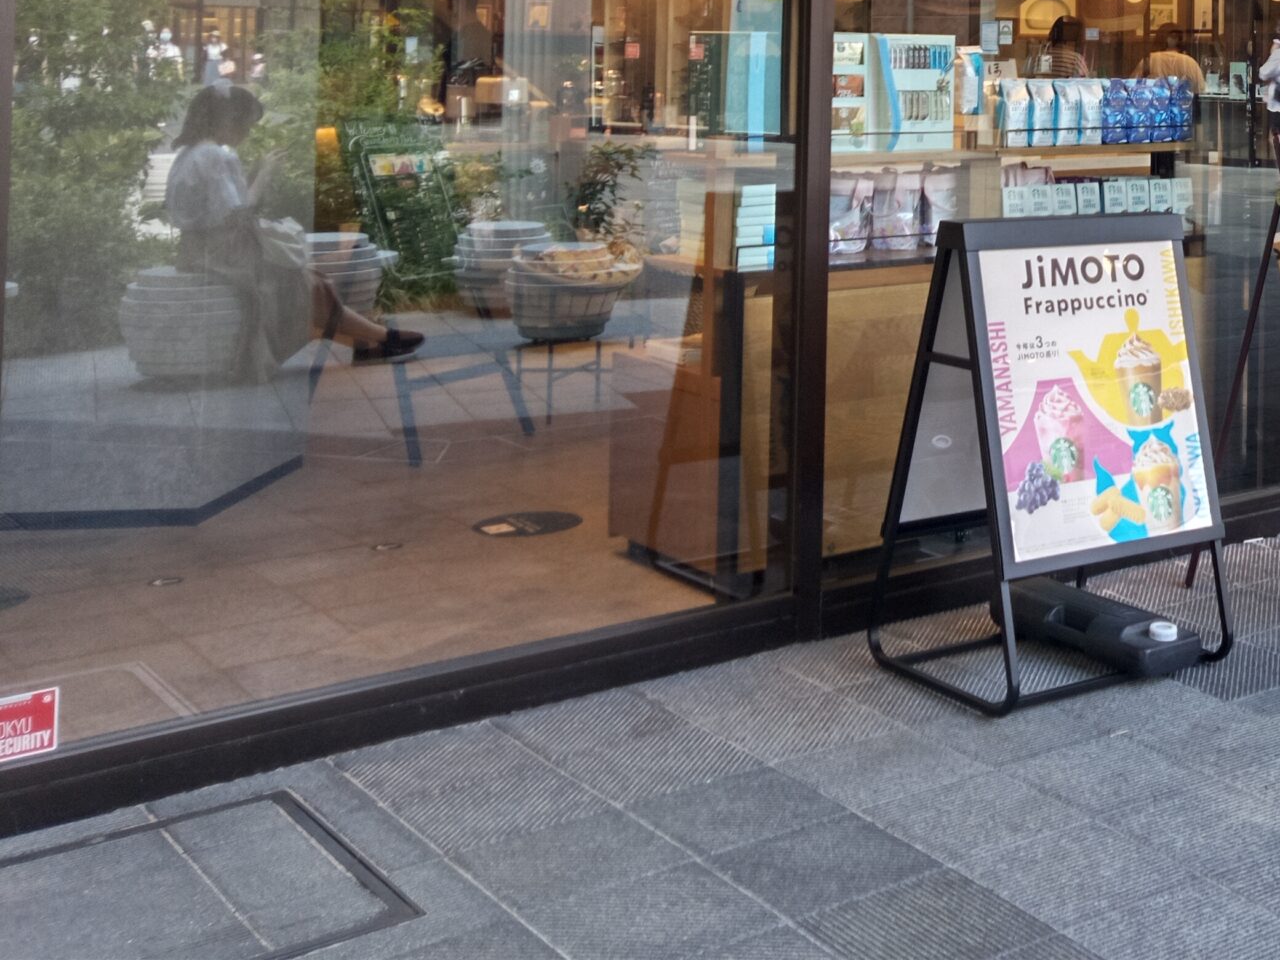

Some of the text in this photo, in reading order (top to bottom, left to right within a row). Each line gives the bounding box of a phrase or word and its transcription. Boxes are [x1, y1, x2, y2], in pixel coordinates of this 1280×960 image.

[1023, 288, 1148, 316] Frappuccino
[1160, 248, 1185, 336] ISHIKAWA
[988, 321, 1018, 437] YAMANASHI
